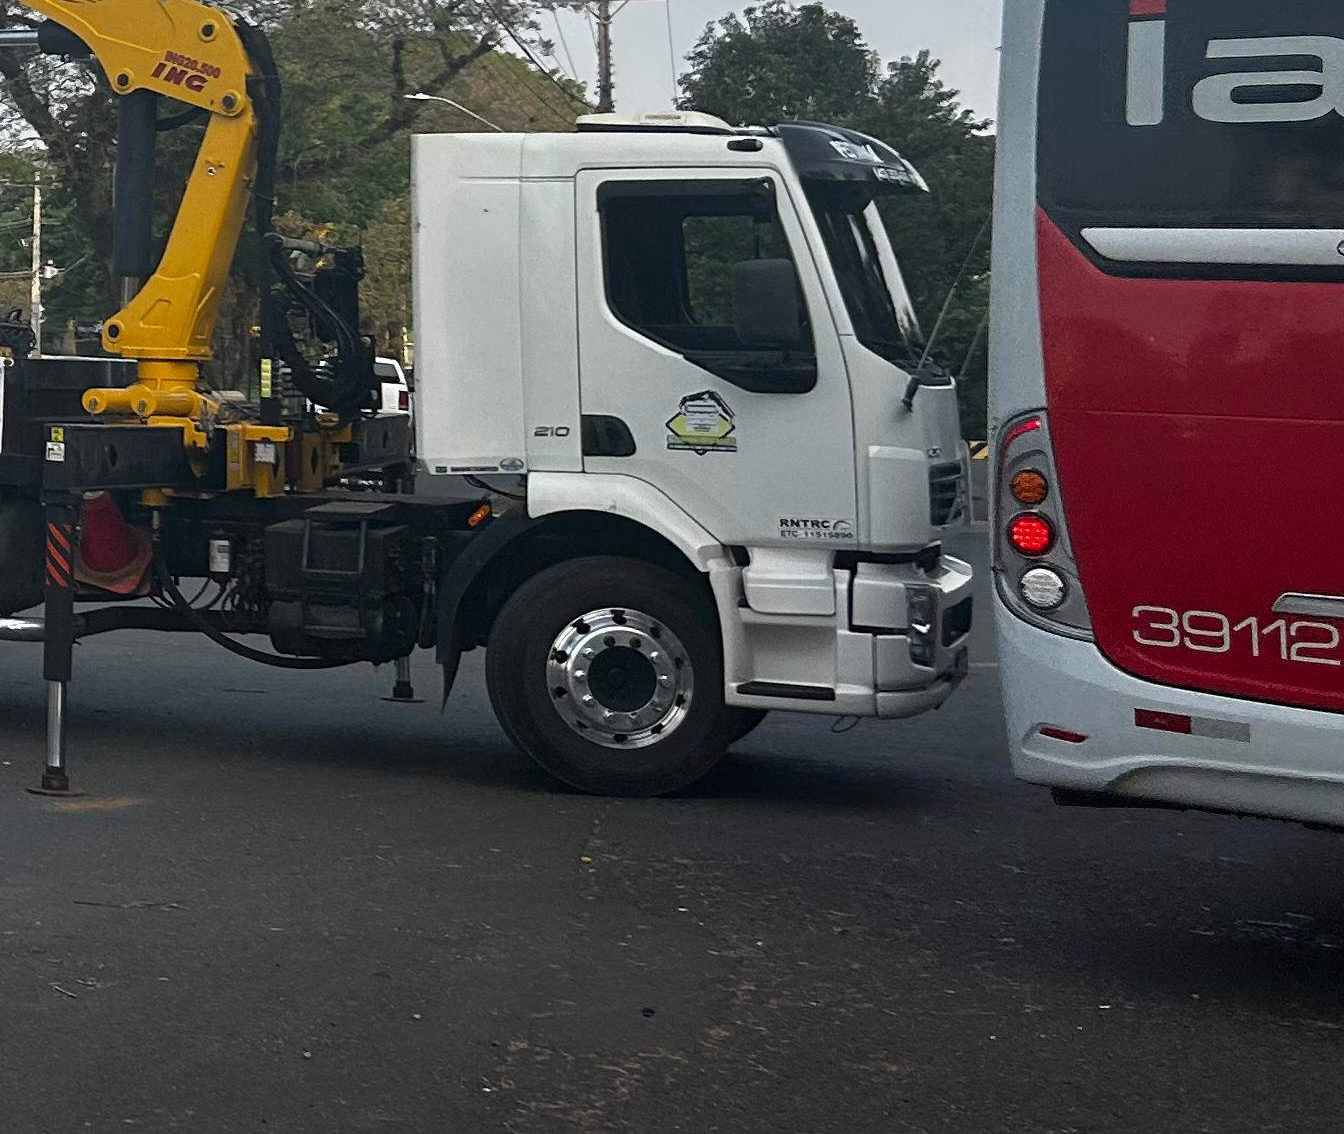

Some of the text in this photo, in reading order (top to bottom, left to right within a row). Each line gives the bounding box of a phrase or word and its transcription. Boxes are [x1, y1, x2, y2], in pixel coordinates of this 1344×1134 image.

[150, 61, 209, 93] ING
[534, 426, 570, 437] 210
[779, 518, 831, 529] RNTRC
[1132, 605, 1341, 666] 39112
